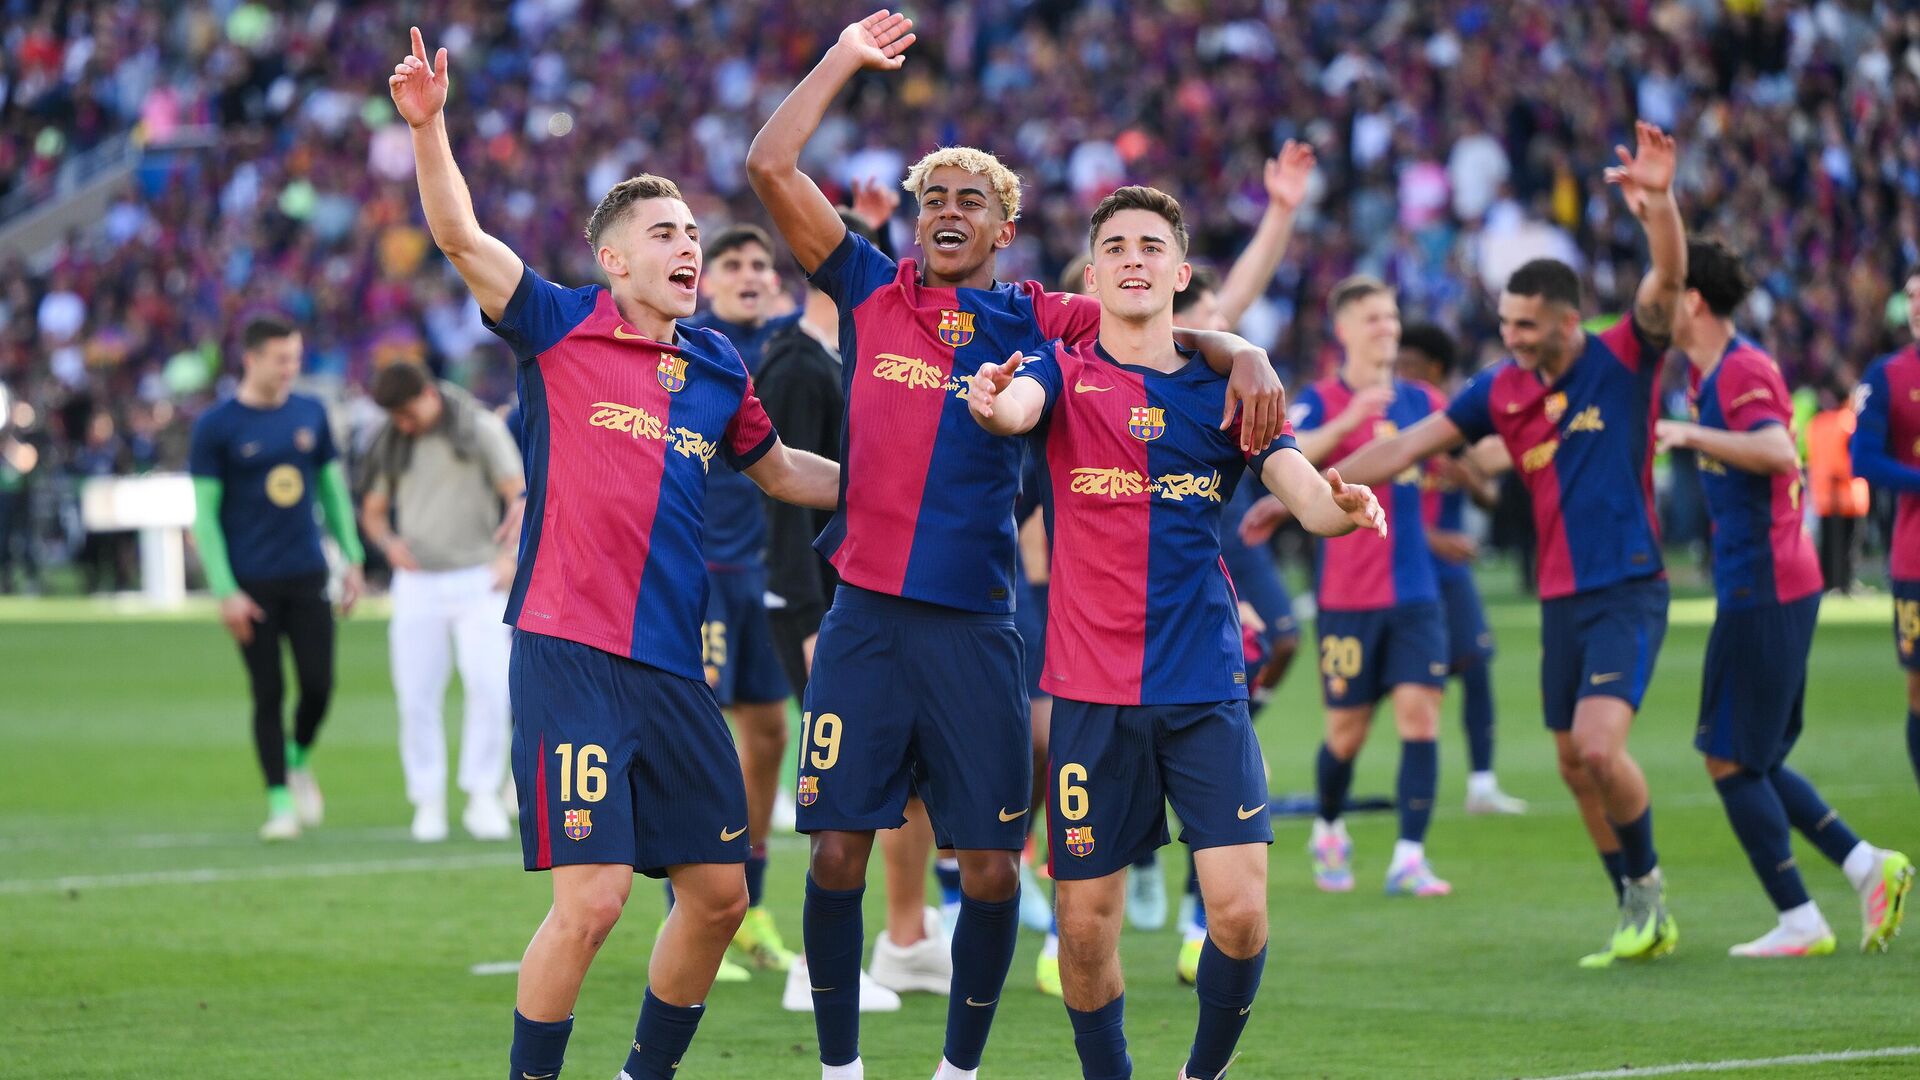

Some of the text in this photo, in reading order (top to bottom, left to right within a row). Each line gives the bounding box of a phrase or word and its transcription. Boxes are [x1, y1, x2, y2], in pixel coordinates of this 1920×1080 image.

[1320, 635, 1362, 678] 20
[801, 711, 843, 770] 19
[555, 743, 608, 802] 16
[1059, 763, 1089, 821] 6
